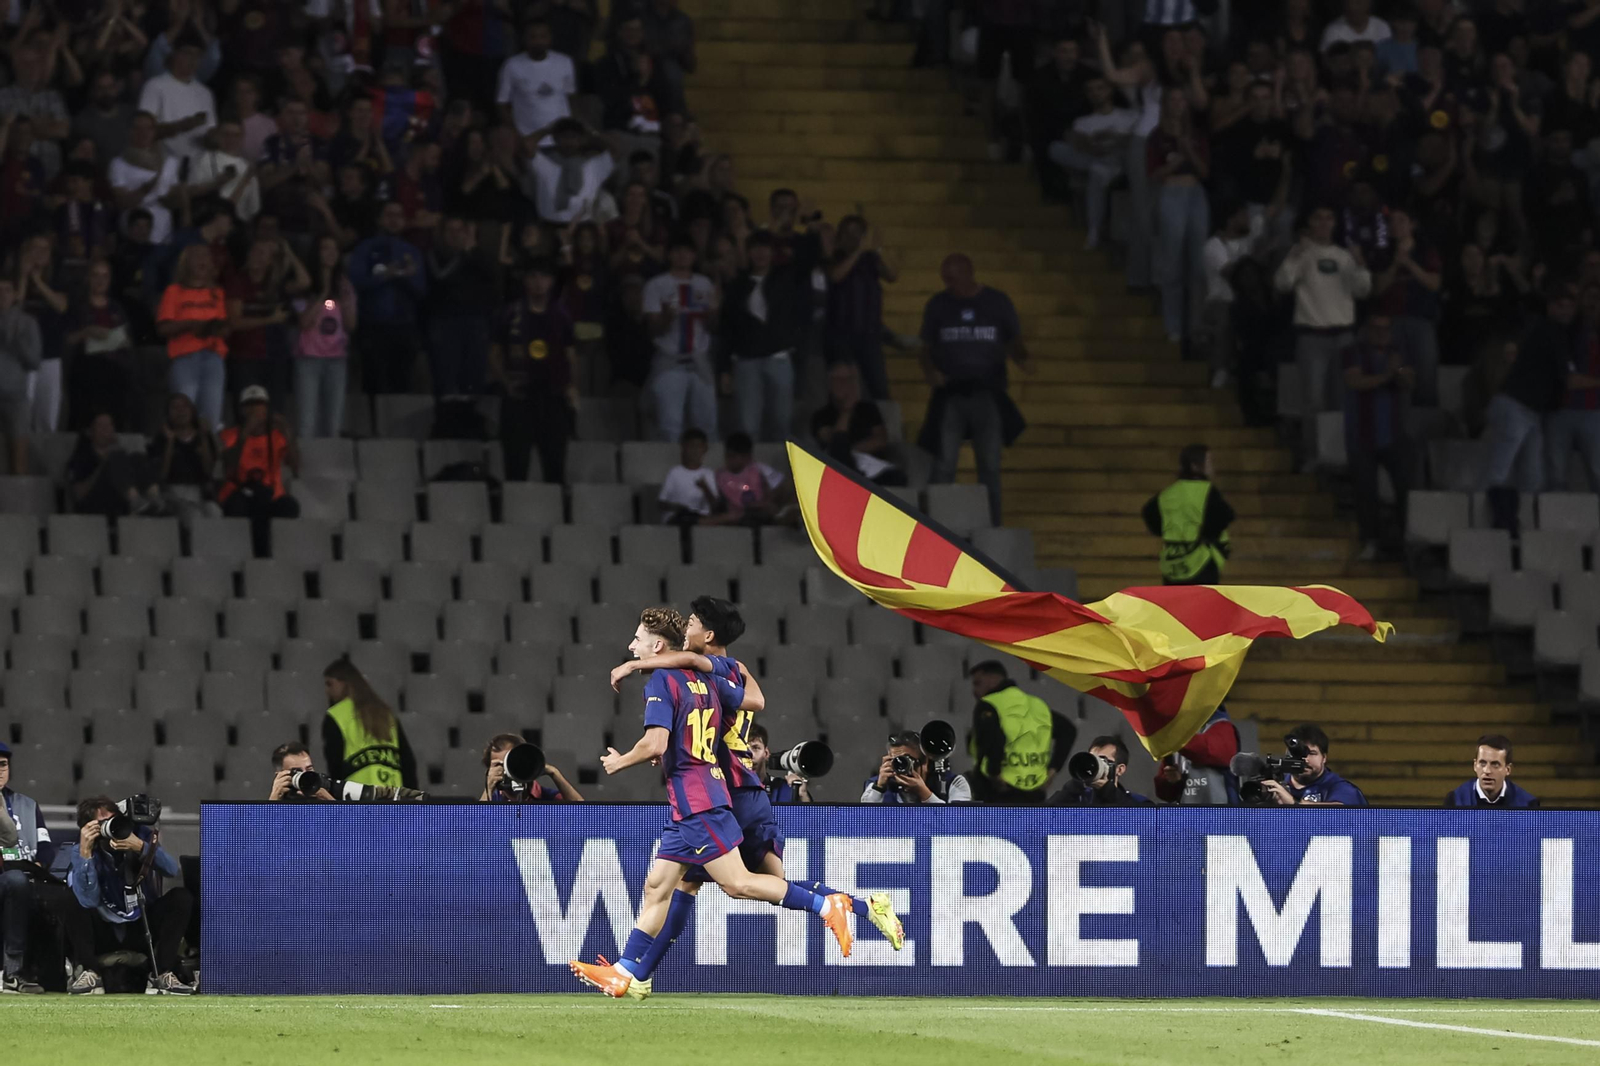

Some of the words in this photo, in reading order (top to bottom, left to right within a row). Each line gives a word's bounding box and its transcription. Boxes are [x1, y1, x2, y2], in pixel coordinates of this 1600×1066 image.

[686, 708, 717, 765] 16
[511, 835, 1139, 967] WHERE
[1206, 835, 1600, 970] MILL
